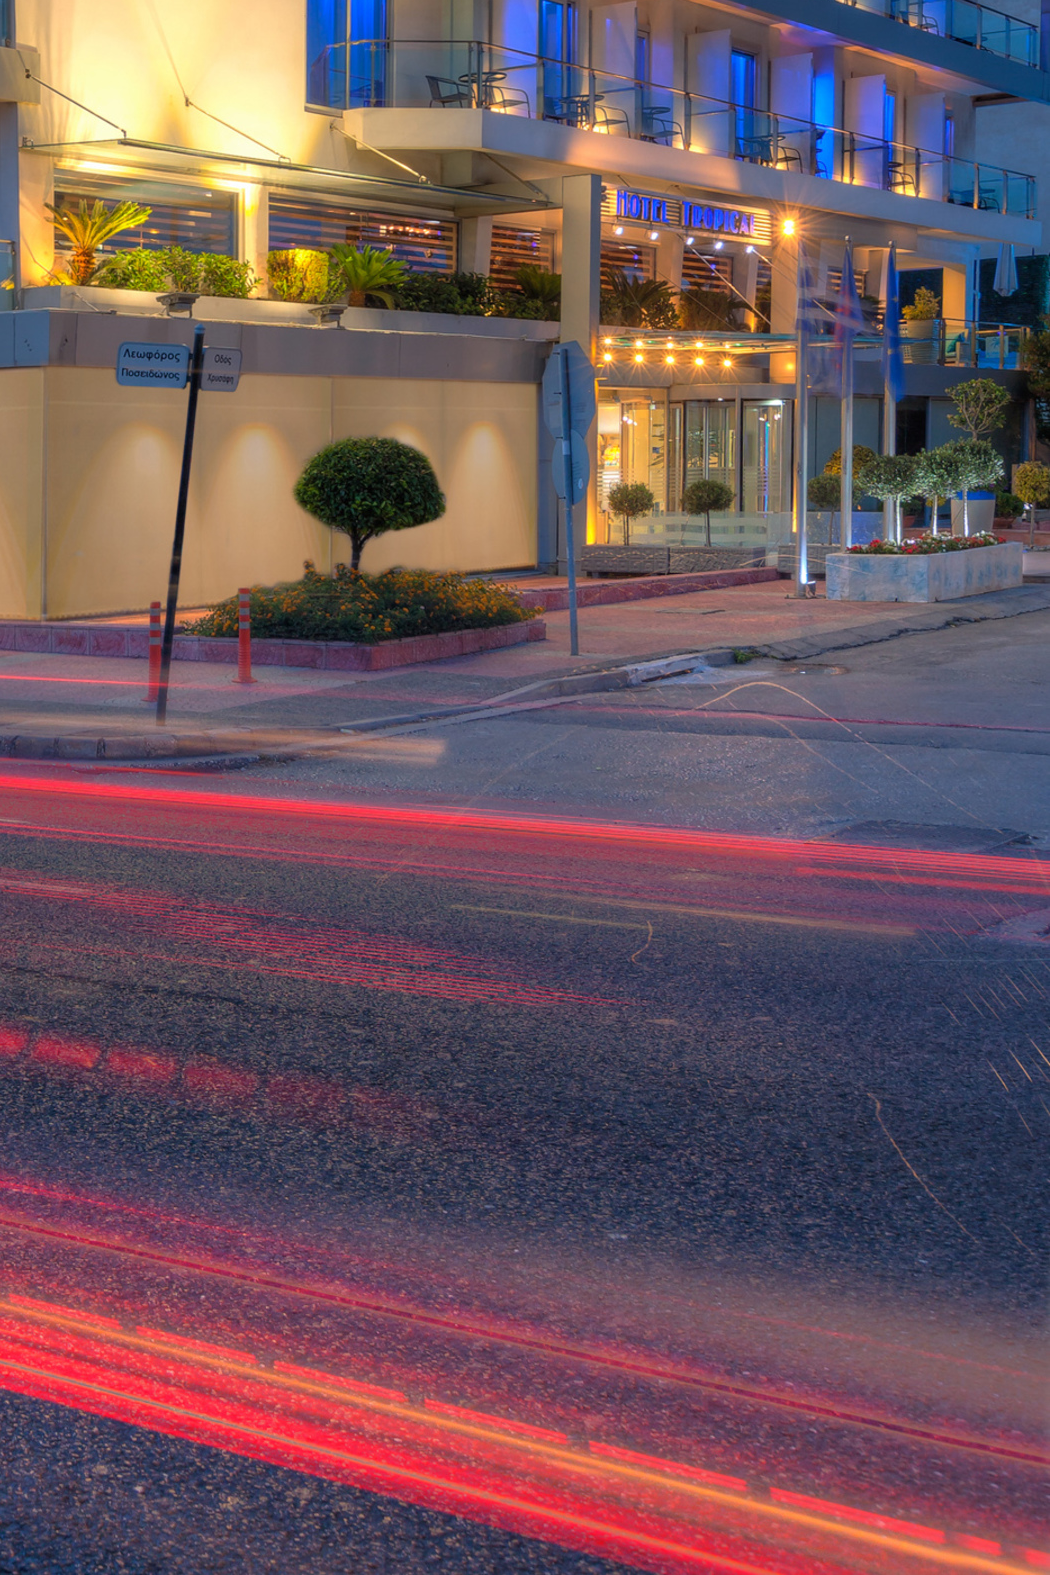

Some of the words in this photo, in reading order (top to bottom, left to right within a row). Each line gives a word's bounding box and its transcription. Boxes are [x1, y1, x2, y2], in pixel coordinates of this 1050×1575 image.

[616, 190, 670, 223] HOTEL
[123, 348, 181, 363] Λεωφόρος
[214, 354, 232, 366] Οδός
[121, 367, 180, 382] Ποσειδώνος
[207, 372, 234, 385] Χρυσάφη
